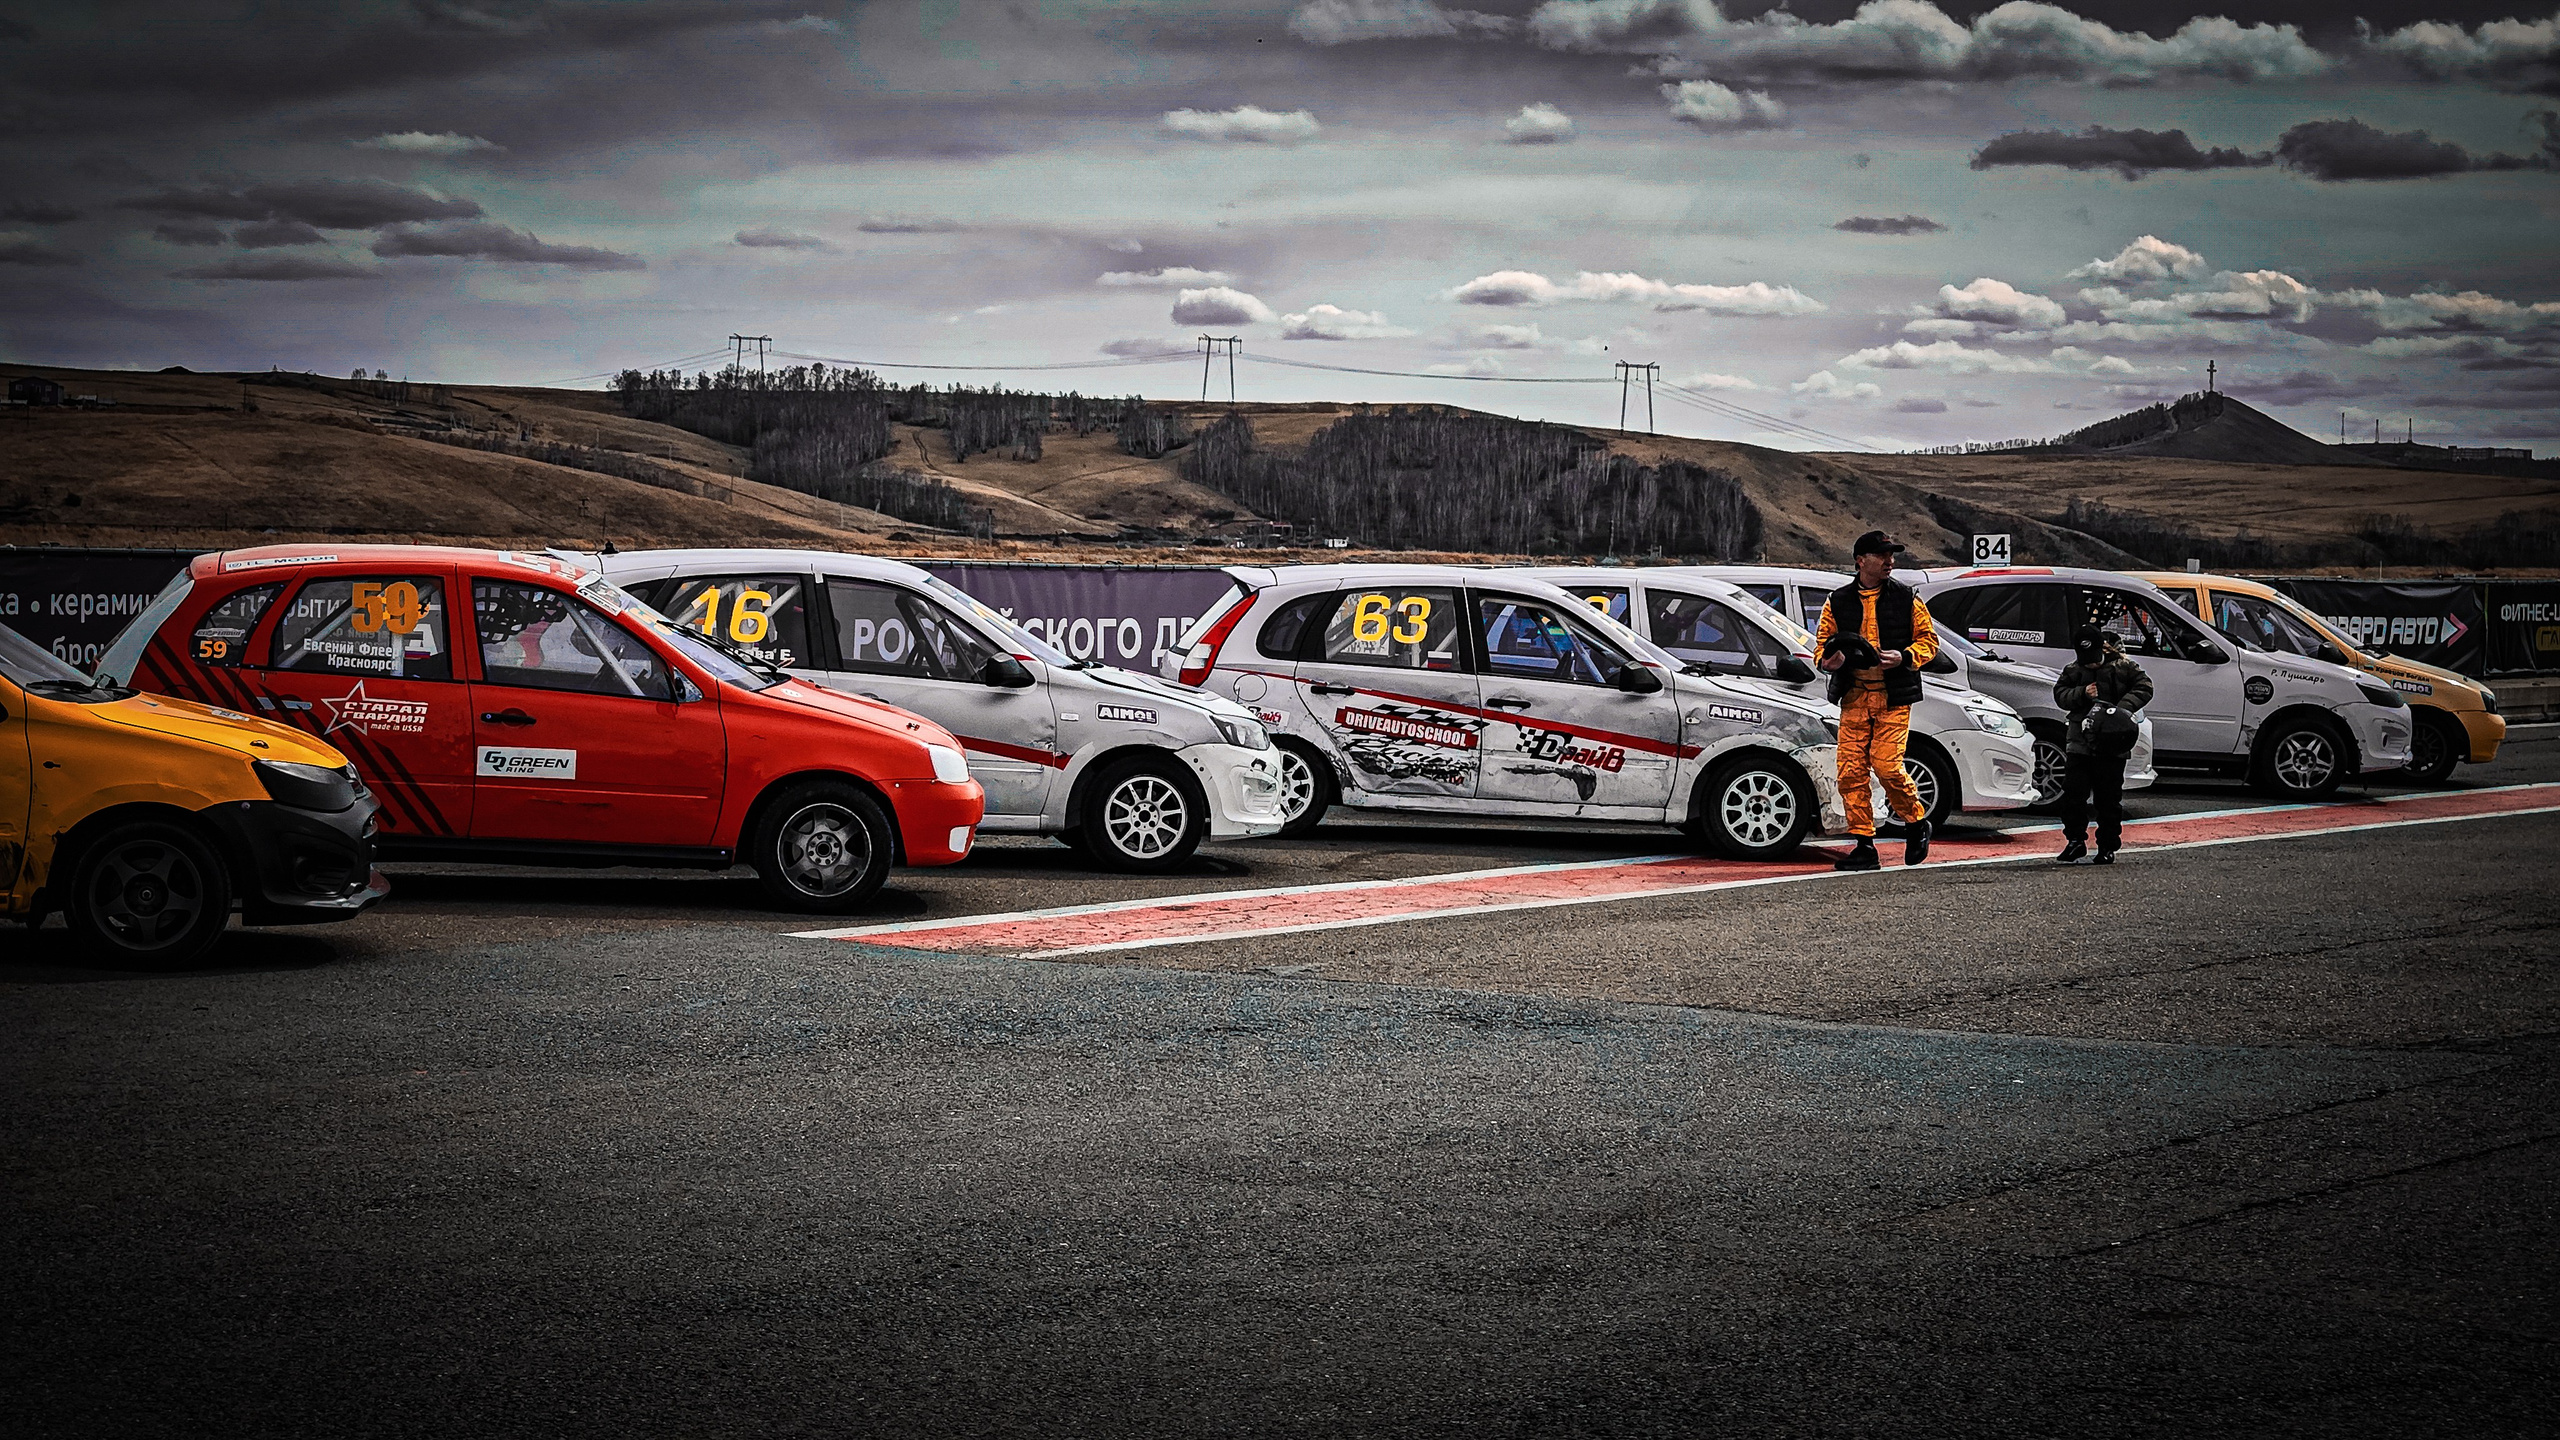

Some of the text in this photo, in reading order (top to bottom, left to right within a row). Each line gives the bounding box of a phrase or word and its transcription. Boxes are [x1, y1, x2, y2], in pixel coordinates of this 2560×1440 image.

[1975, 537, 2008, 560] 84
[352, 581, 419, 634] 59
[691, 588, 772, 643] 16
[1353, 595, 1431, 643] 63
[2389, 617, 2439, 645] АВТО
[53, 636, 107, 666] бро
[199, 641, 227, 658] 59
[303, 638, 401, 660] Евгений Флеер
[327, 654, 399, 672] Красноярск
[2280, 670, 2325, 685] Пушкарь
[2393, 681, 2431, 694] AIMOL
[341, 711, 426, 724] ГВАРДИЯ
[344, 702, 428, 715] СТАРАЯ
[1099, 704, 1156, 724] AIMOL
[1710, 705, 1762, 722] AIMOL
[370, 723, 390, 731] made
[402, 725, 424, 733] USSR
[1346, 710, 1467, 747] DRIVEAUTOSCHOOL
[508, 757, 569, 769] GREEN
